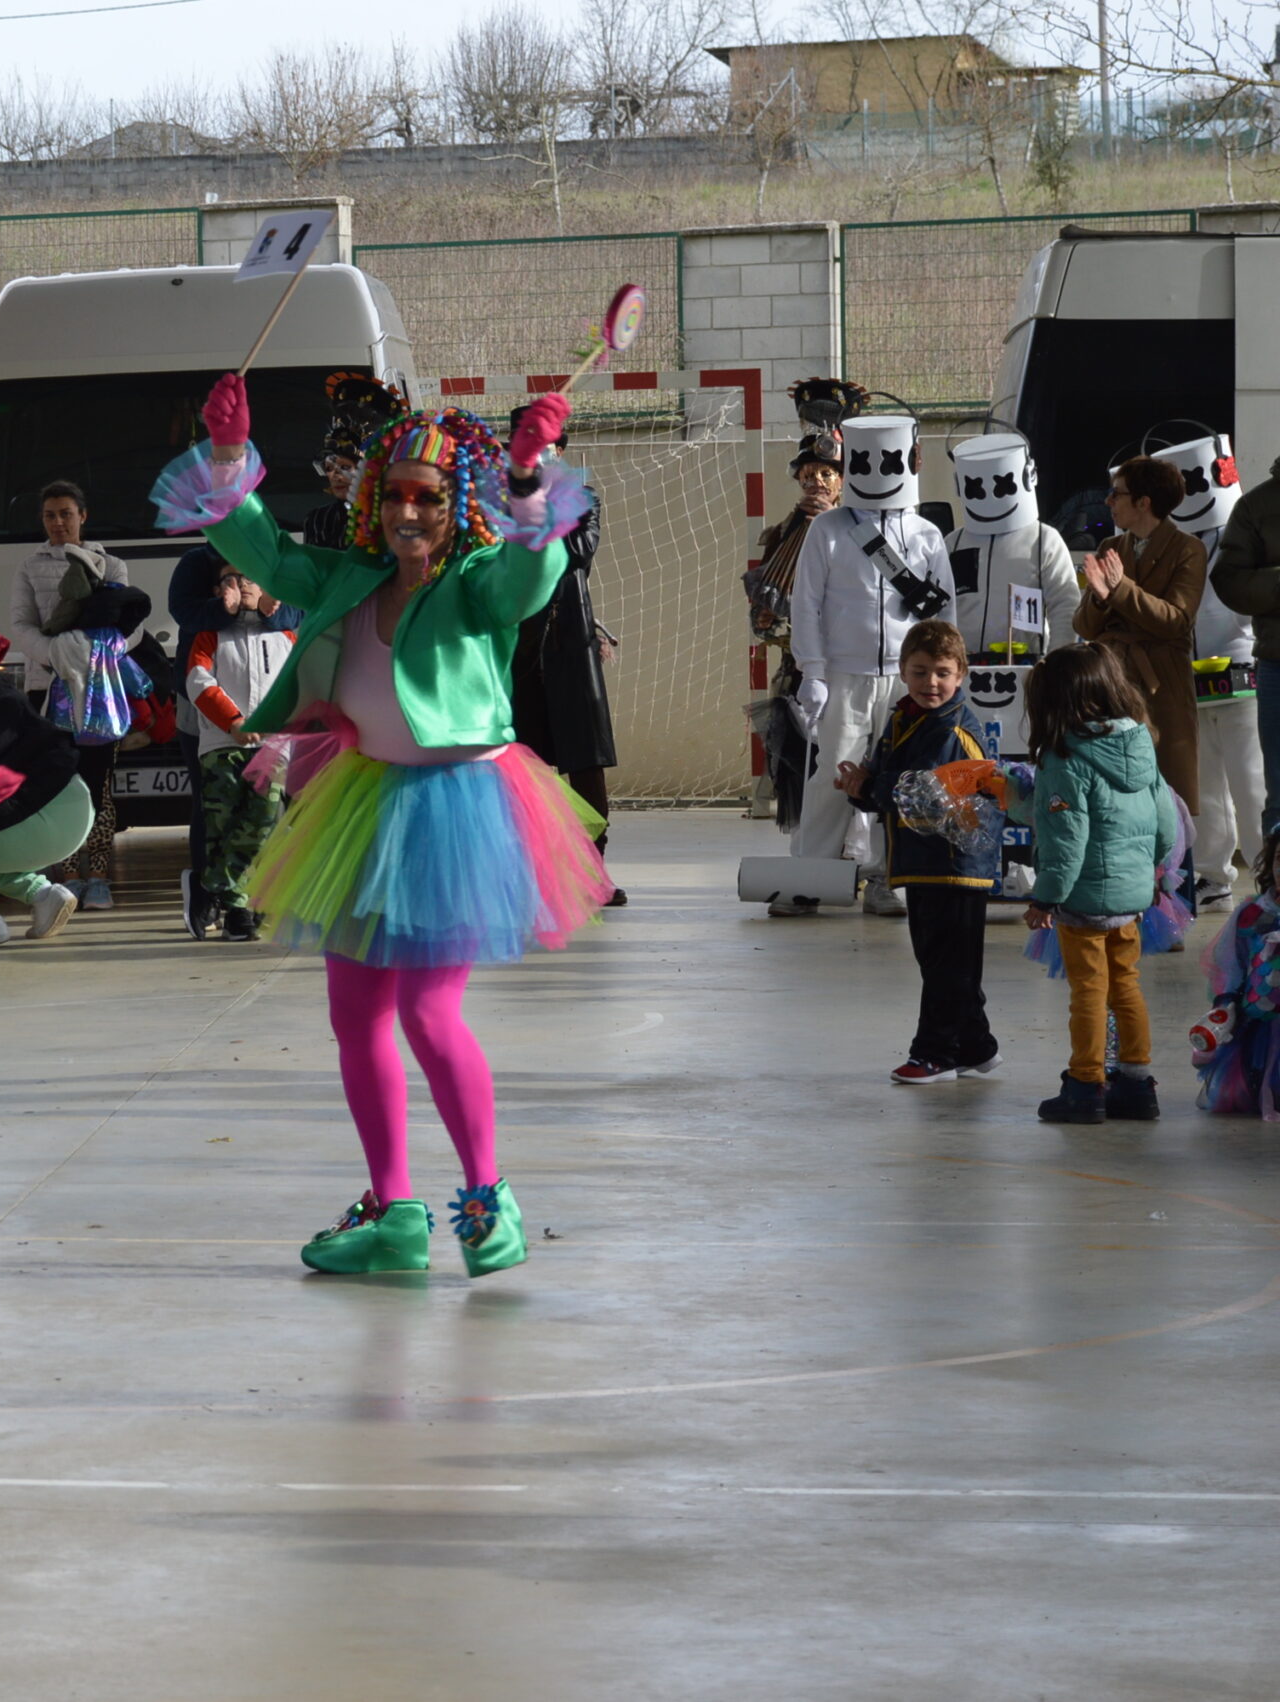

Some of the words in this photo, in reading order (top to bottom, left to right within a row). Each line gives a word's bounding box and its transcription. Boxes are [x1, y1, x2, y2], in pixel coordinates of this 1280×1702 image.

[283, 223, 312, 261] 4
[1026, 596, 1039, 625] 11
[112, 772, 140, 794] LE
[152, 770, 192, 793] 407
